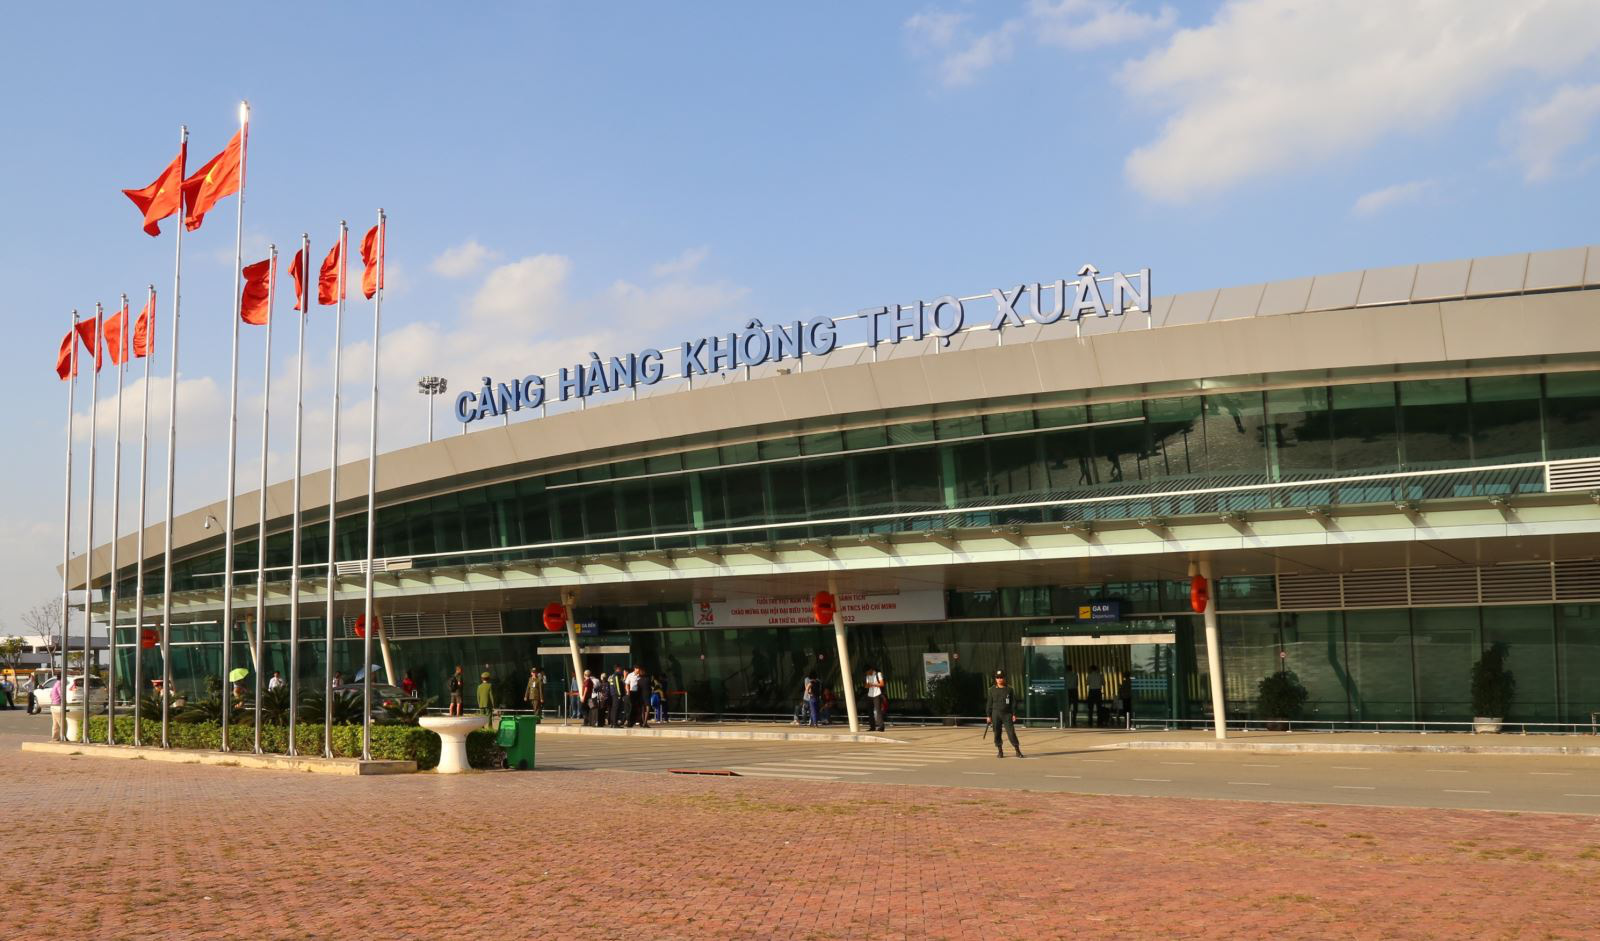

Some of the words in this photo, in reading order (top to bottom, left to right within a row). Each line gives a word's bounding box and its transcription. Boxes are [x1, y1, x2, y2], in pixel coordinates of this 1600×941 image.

[455, 374, 545, 423] CẢNG
[558, 347, 664, 402] HÀNG
[680, 316, 837, 378] KHÔNG
[858, 295, 965, 347] THỌ
[989, 264, 1151, 330] XUÂN
[861, 602, 870, 611] HỒ
